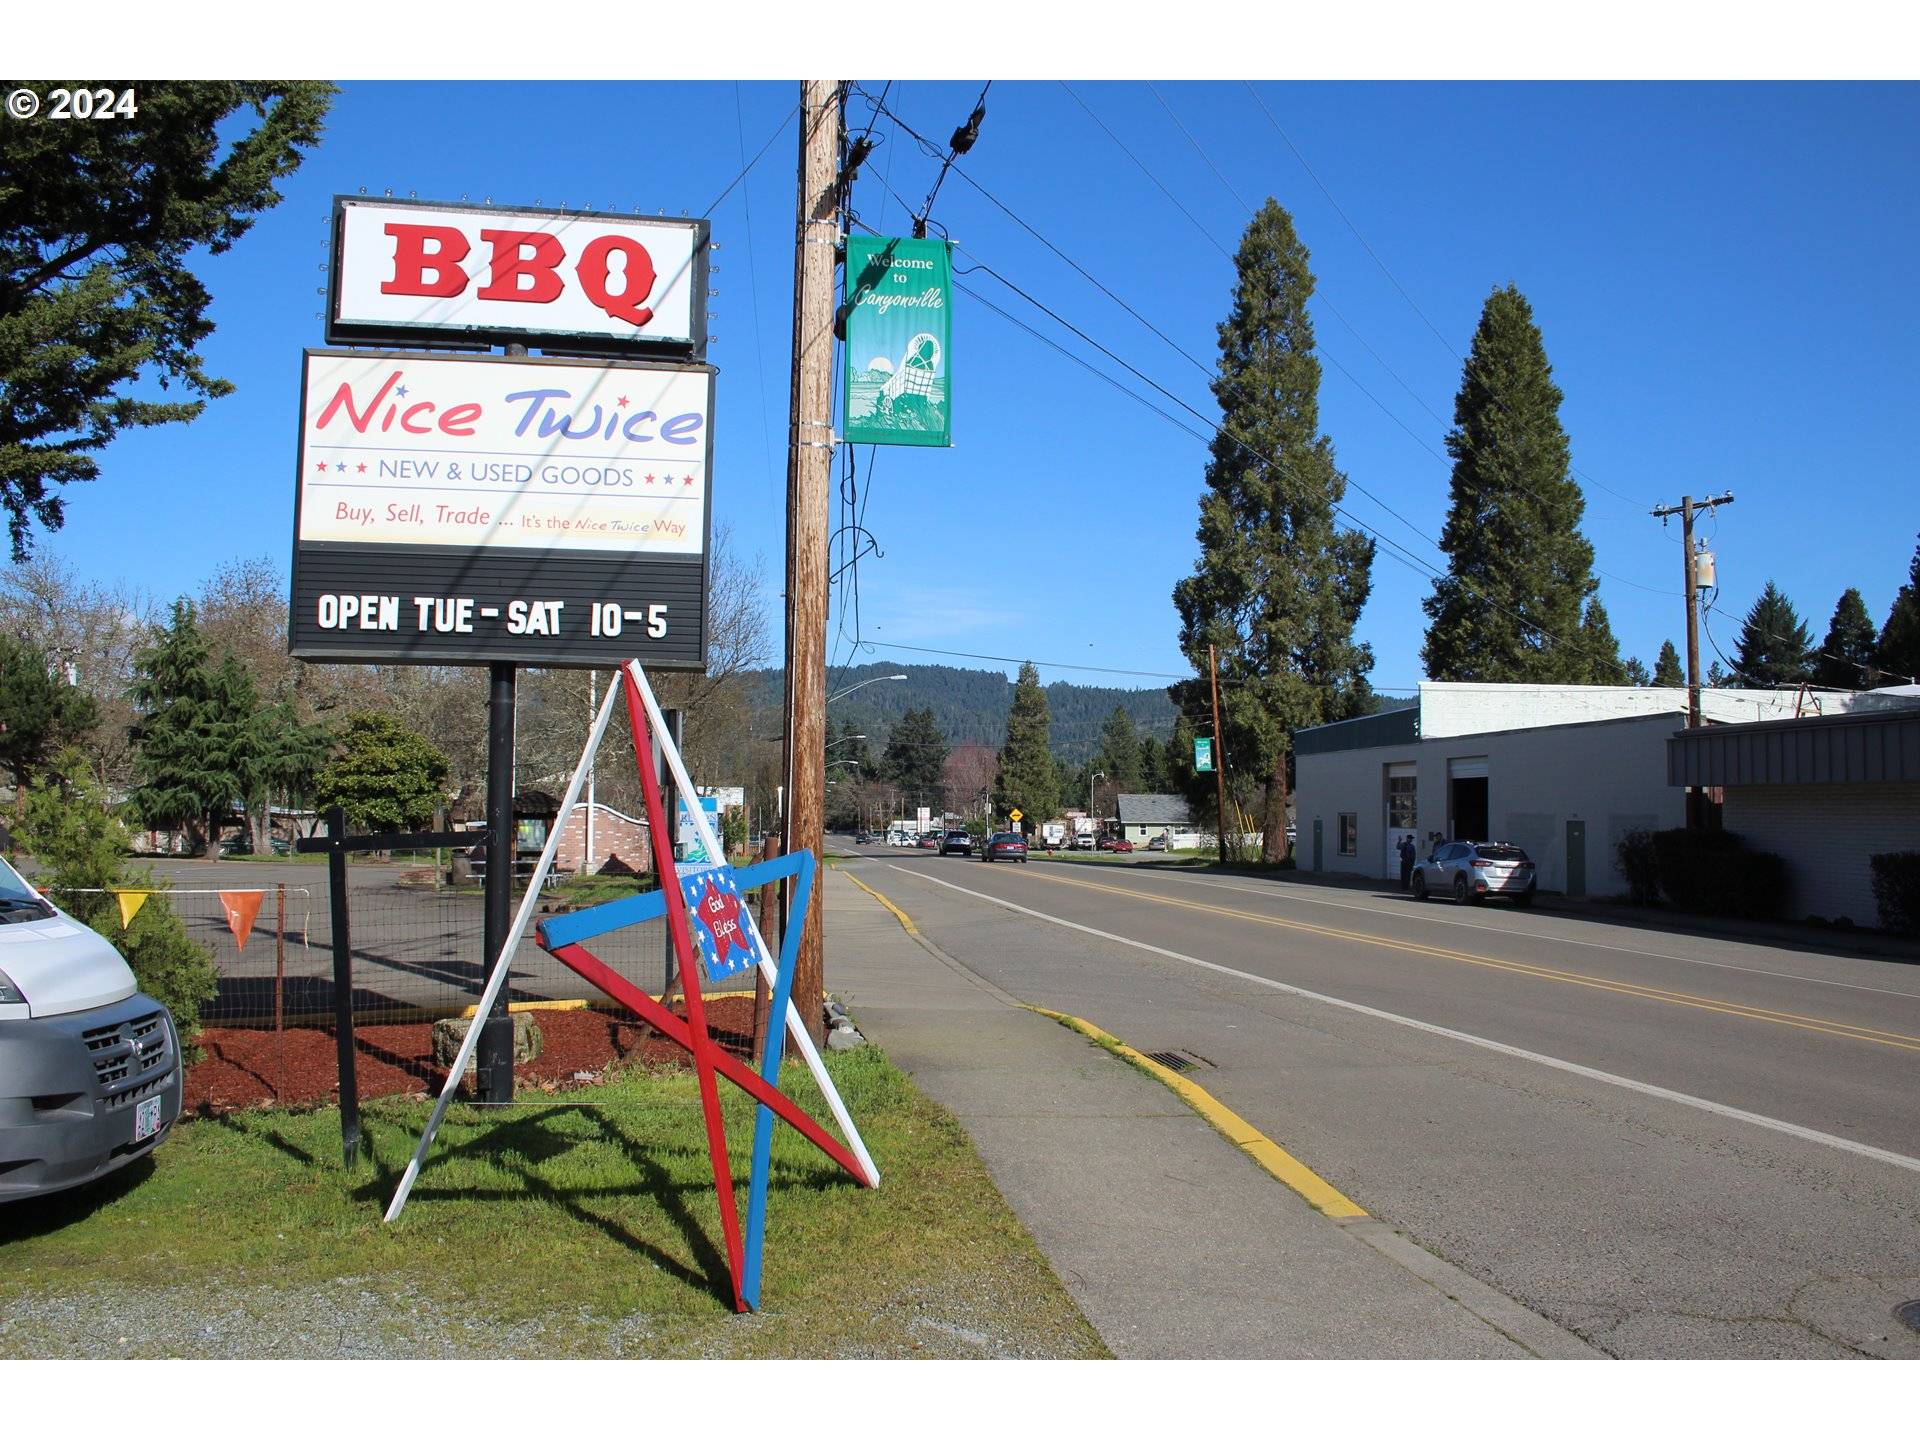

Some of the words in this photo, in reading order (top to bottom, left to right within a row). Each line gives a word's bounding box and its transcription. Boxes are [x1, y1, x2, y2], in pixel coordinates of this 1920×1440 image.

[380, 222, 658, 327] BBQ
[867, 254, 933, 269] Welcome
[893, 273, 907, 283] to
[855, 284, 943, 314] Canyonville
[315, 370, 483, 436] Nice
[504, 388, 704, 446] Twice
[379, 459, 440, 480] NEW
[447, 462, 462, 481] &
[471, 462, 532, 483] USED
[542, 465, 634, 487] GOODS
[335, 502, 375, 525] Buy,
[385, 503, 424, 525] Sell,
[435, 505, 490, 526] Trade
[521, 515, 541, 529] It's
[547, 516, 570, 530] the
[574, 519, 608, 531] Nice
[611, 520, 649, 532] Twice
[653, 519, 687, 537] Way
[317, 594, 399, 631] OPEN
[590, 602, 668, 639] 10-5
[708, 893, 725, 913] God
[713, 919, 737, 938] Bless
